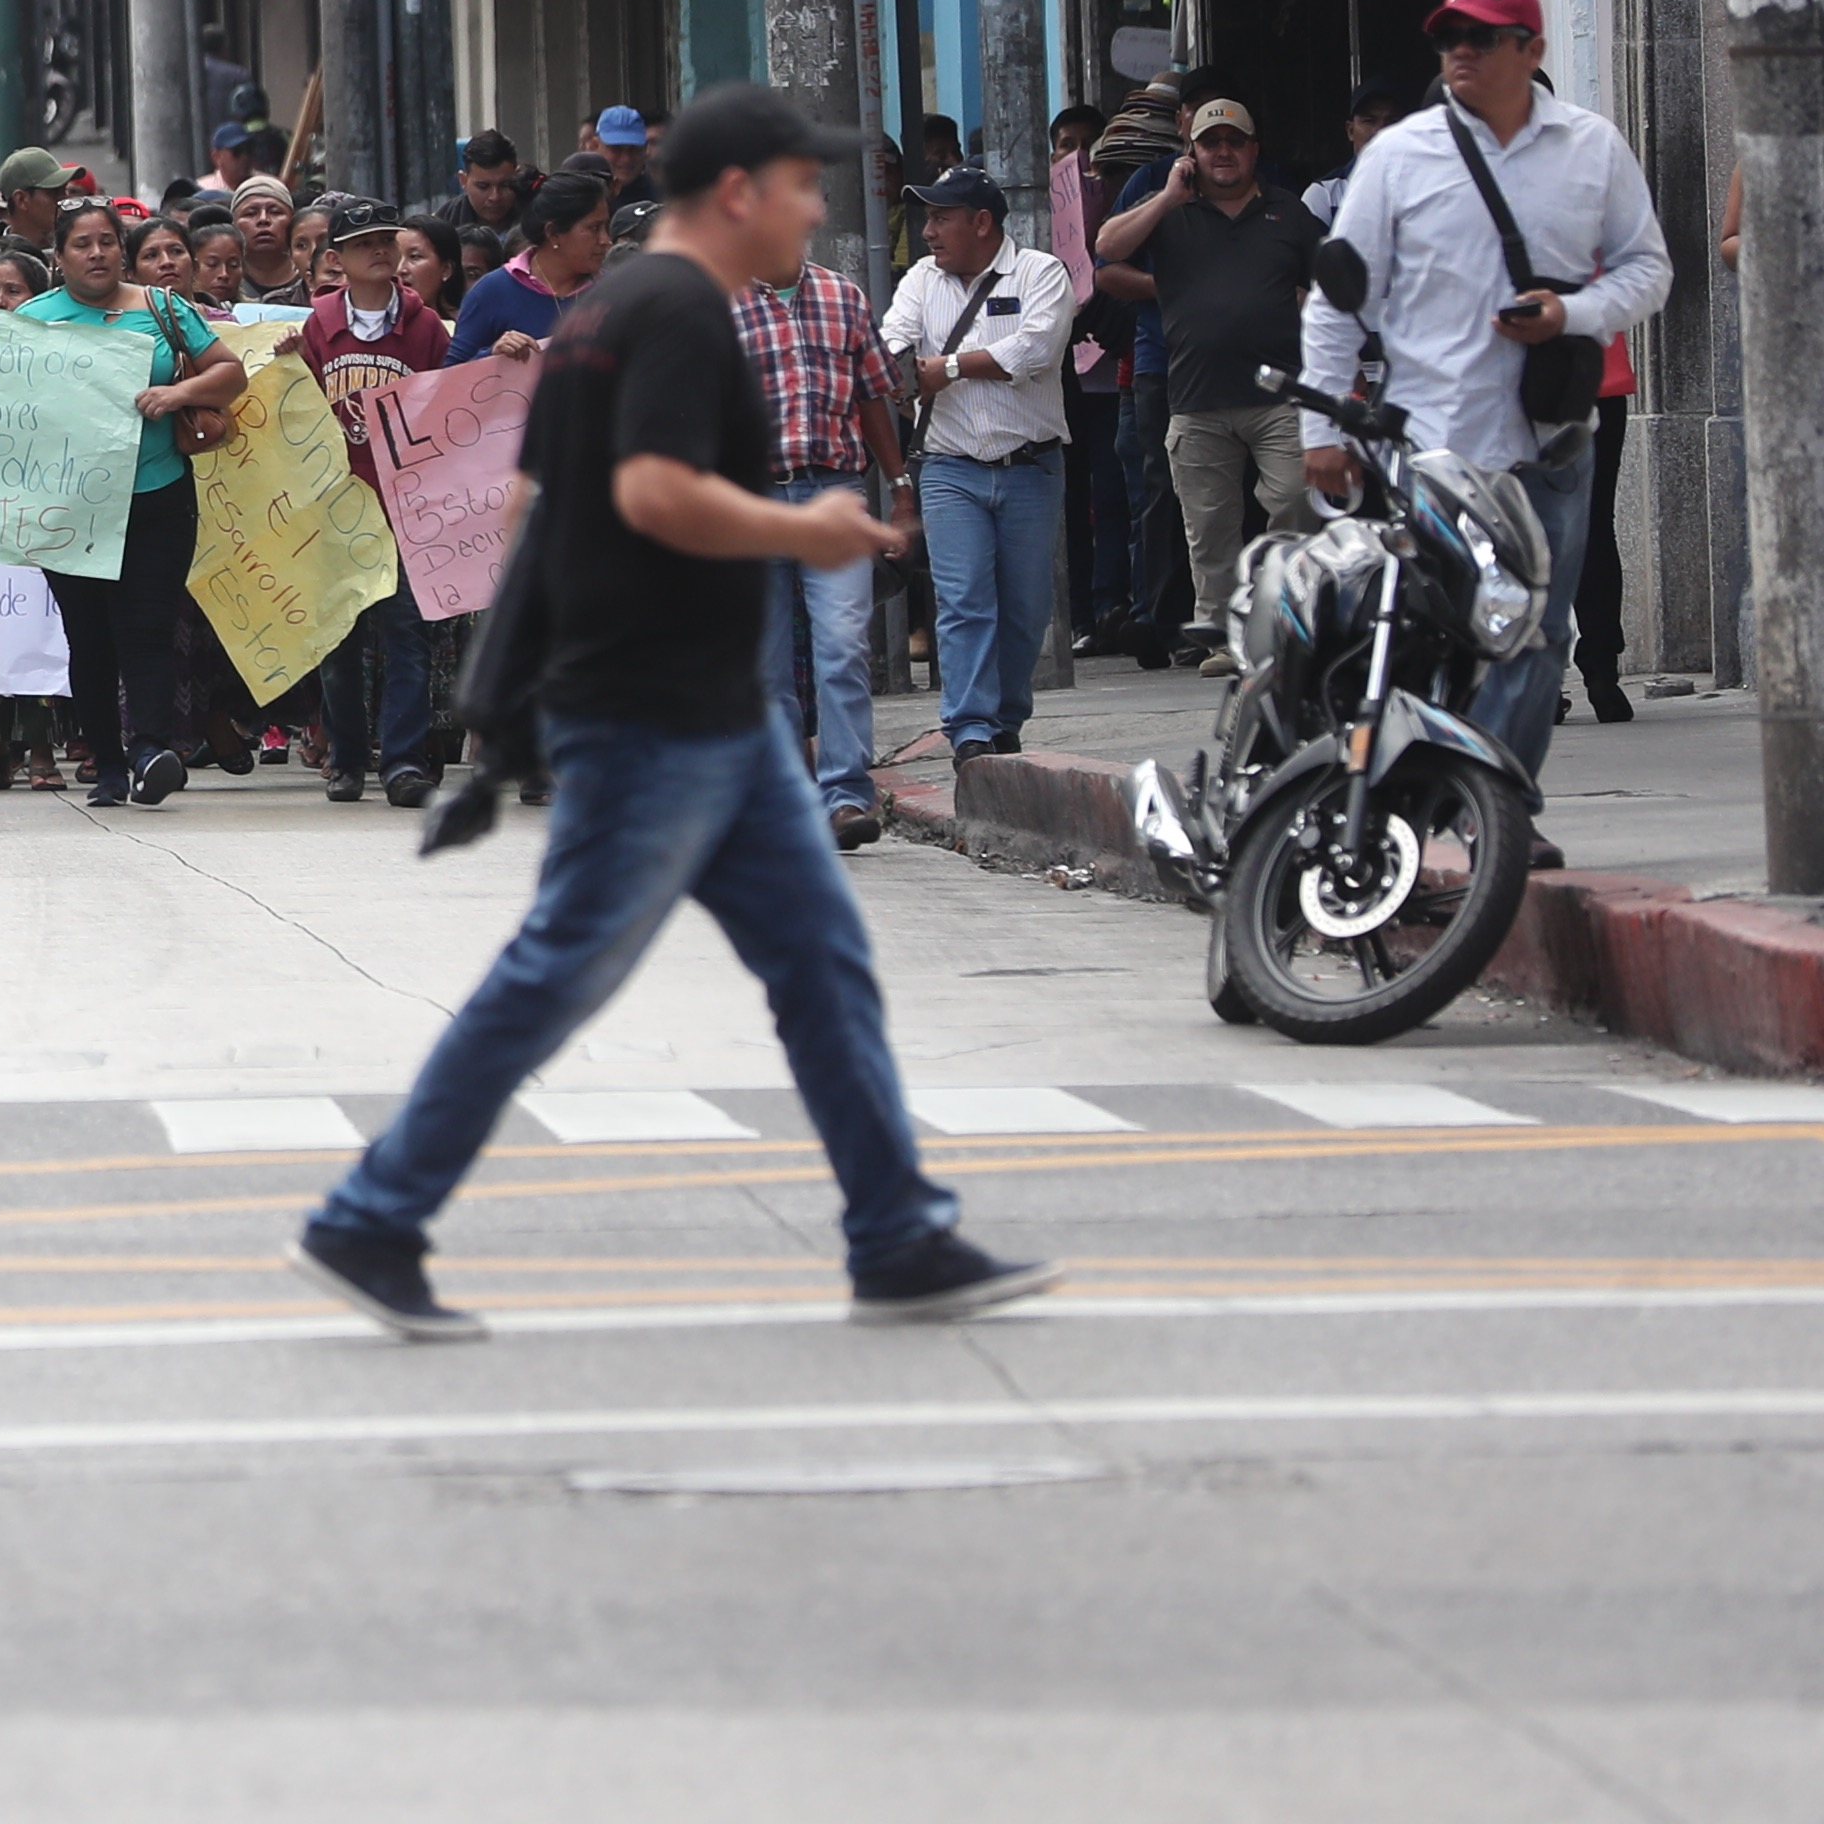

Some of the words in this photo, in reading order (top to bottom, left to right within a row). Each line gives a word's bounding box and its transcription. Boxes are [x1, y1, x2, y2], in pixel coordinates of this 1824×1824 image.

[44, 334, 93, 380] de
[376, 354, 402, 371] SUPER
[0, 578, 27, 617] de
